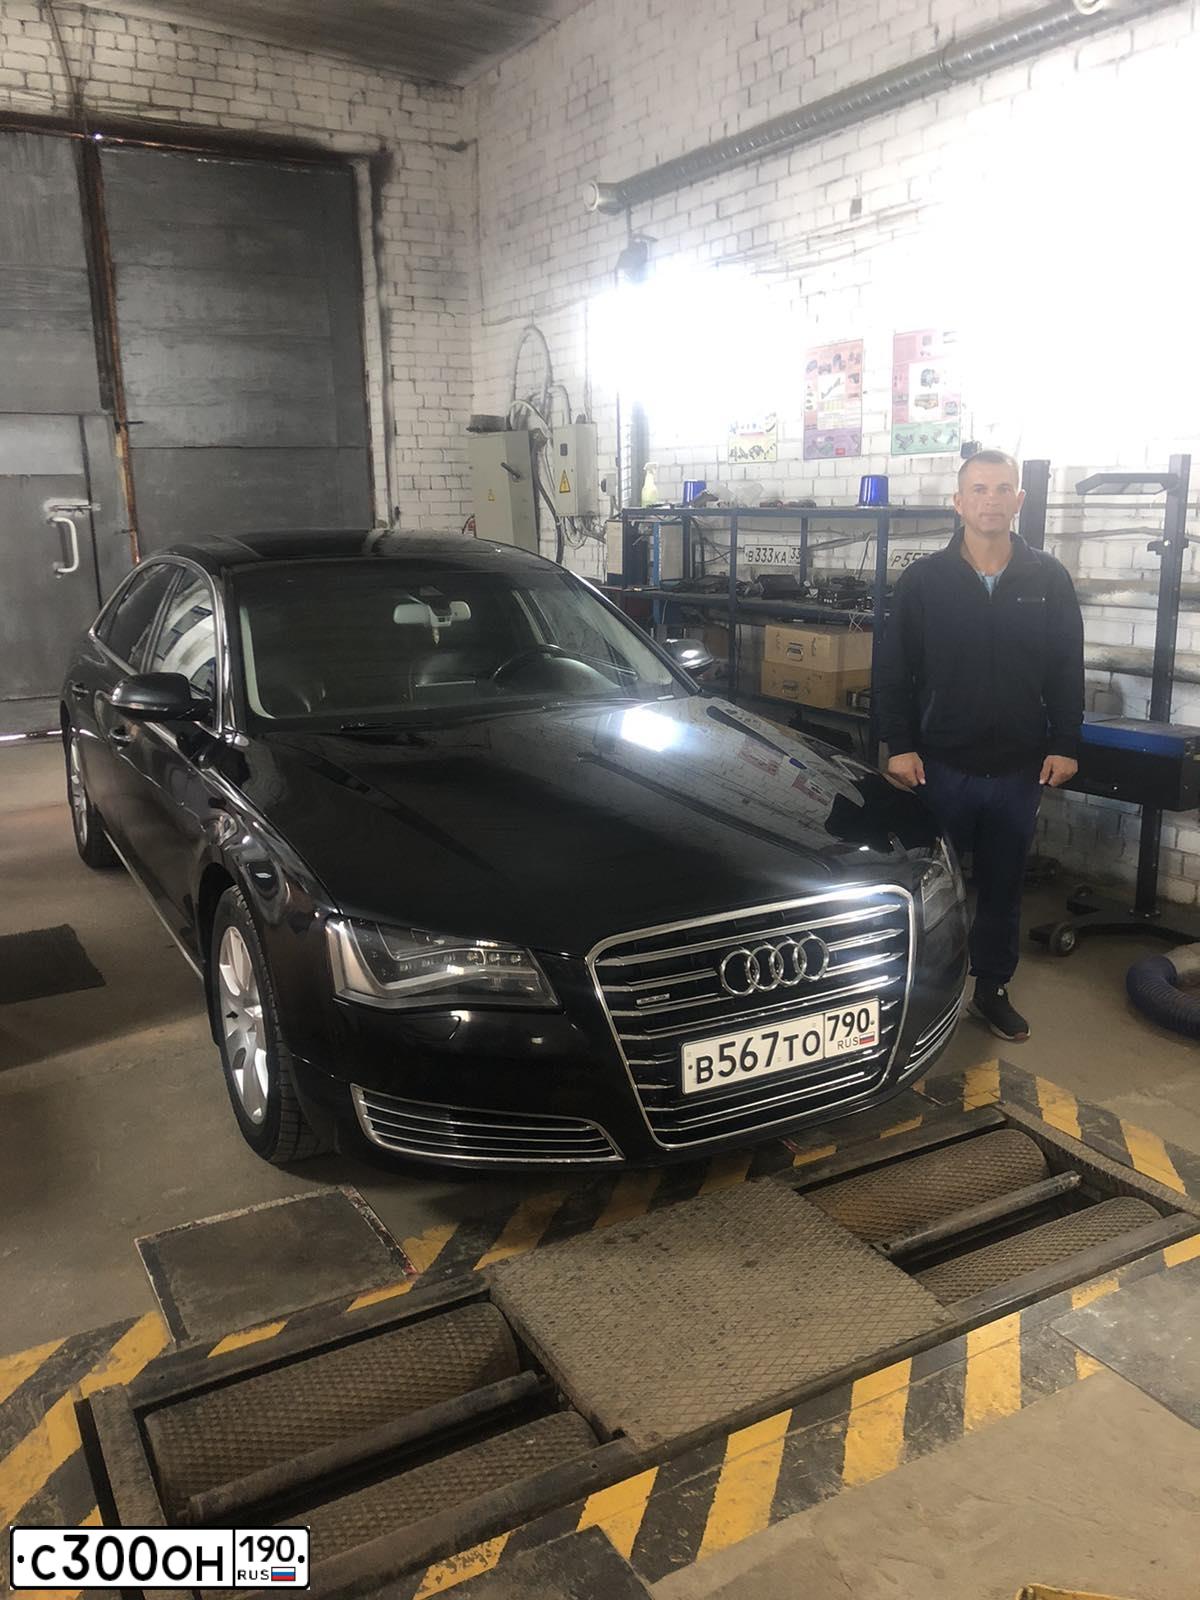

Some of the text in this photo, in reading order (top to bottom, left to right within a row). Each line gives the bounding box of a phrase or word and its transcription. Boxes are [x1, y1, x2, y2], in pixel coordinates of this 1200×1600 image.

[695, 1007, 871, 1085] В567ТО 790
[837, 1036, 859, 1050] RUS
